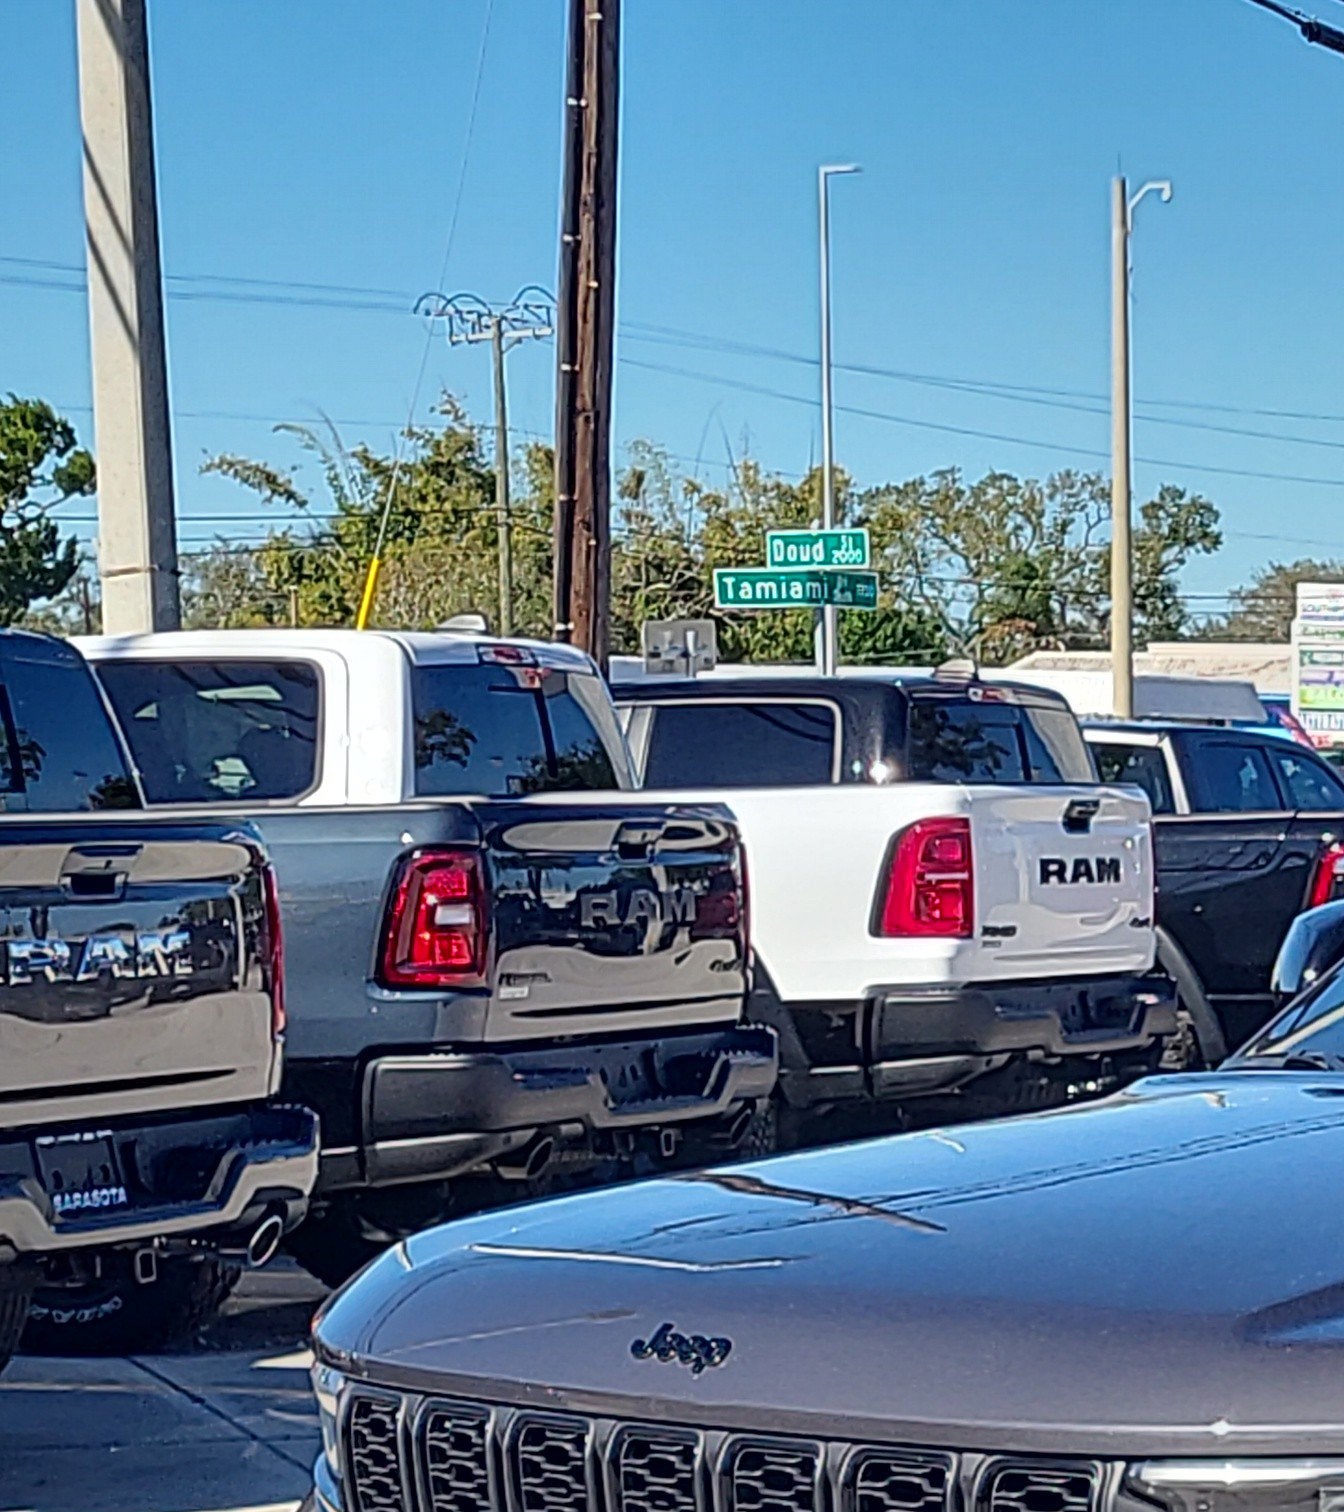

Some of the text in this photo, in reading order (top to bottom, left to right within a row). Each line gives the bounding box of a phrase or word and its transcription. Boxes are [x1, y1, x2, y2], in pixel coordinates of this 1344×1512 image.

[772, 538, 825, 562] Doud
[722, 575, 828, 600] Tamiami
[1039, 857, 1121, 885] RAM
[580, 888, 698, 928] RAM
[8, 931, 195, 986] RAM
[53, 1187, 128, 1213] SARASOTA
[630, 1322, 733, 1375] Jeep
